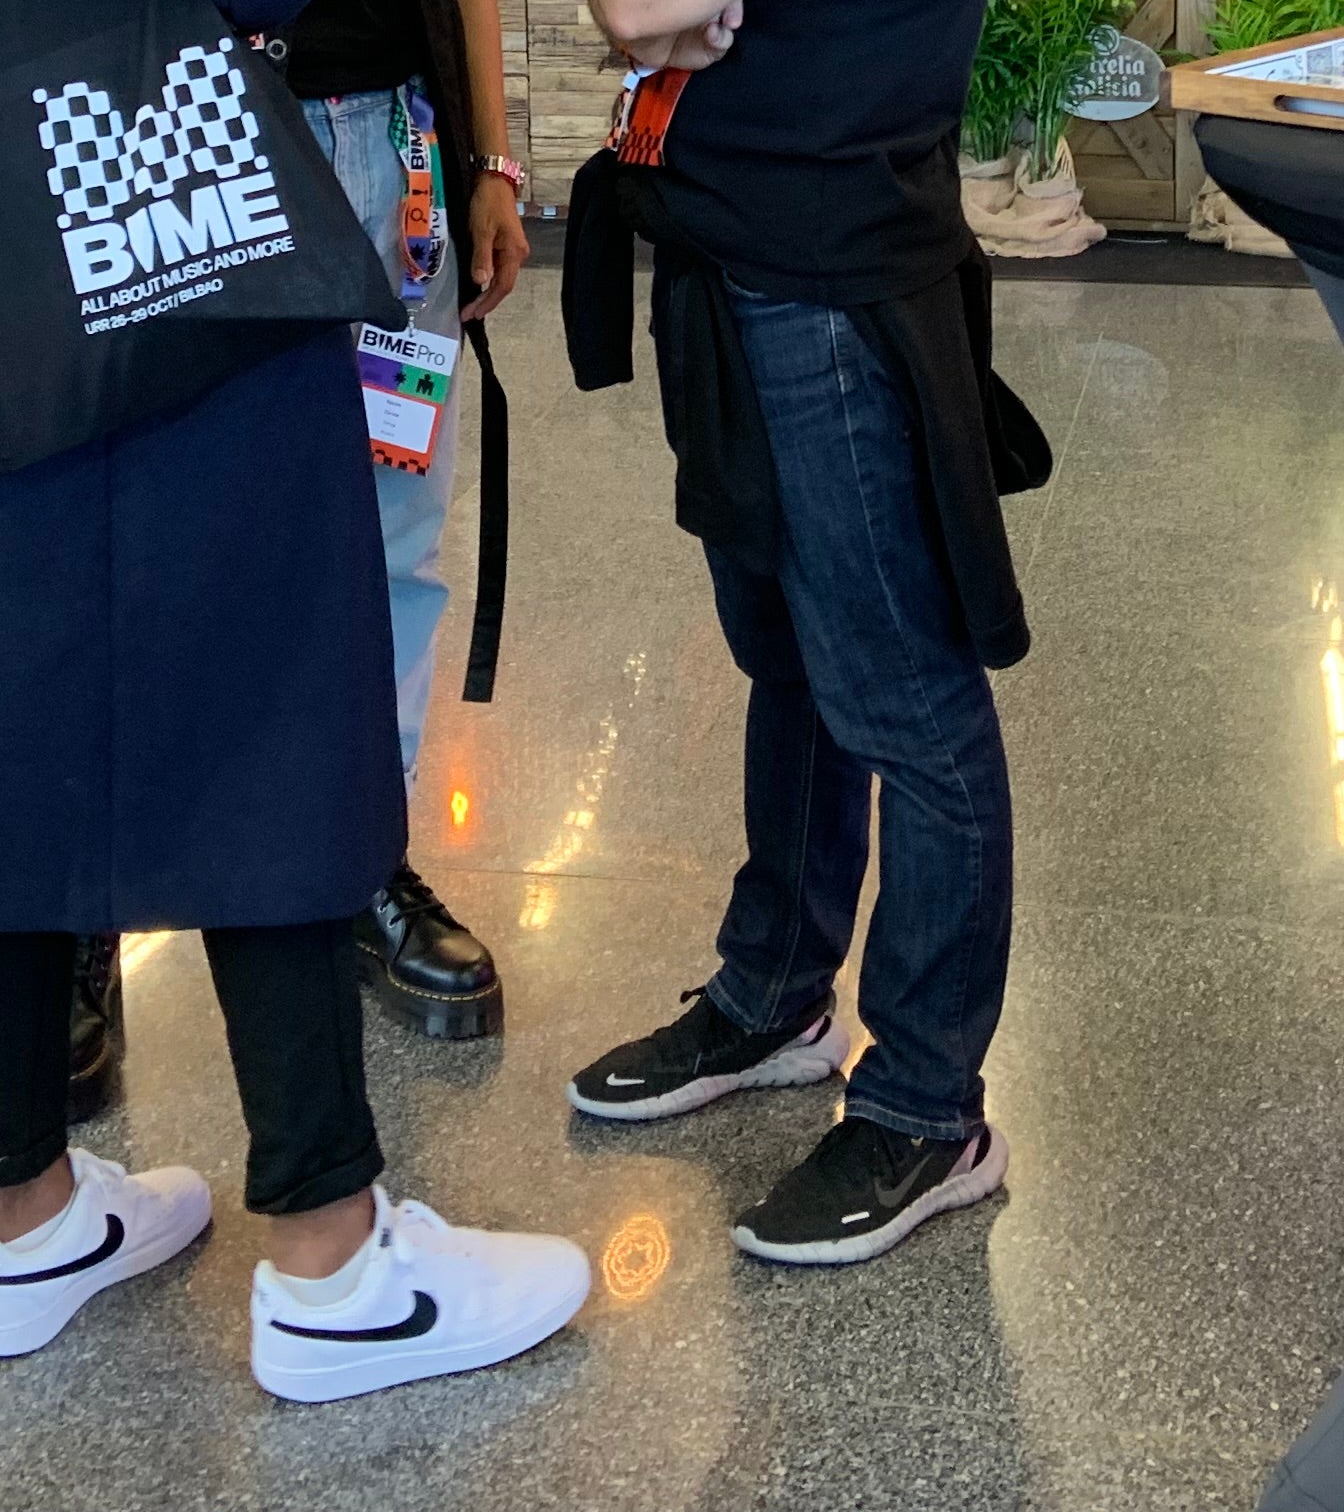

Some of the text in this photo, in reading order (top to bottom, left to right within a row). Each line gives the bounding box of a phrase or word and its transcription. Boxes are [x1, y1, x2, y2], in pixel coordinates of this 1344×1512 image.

[62, 171, 289, 295] BIME
[80, 235, 296, 317] ALL ABOUT MUSIC AND MORE
[178, 277, 225, 304] BILBAO
